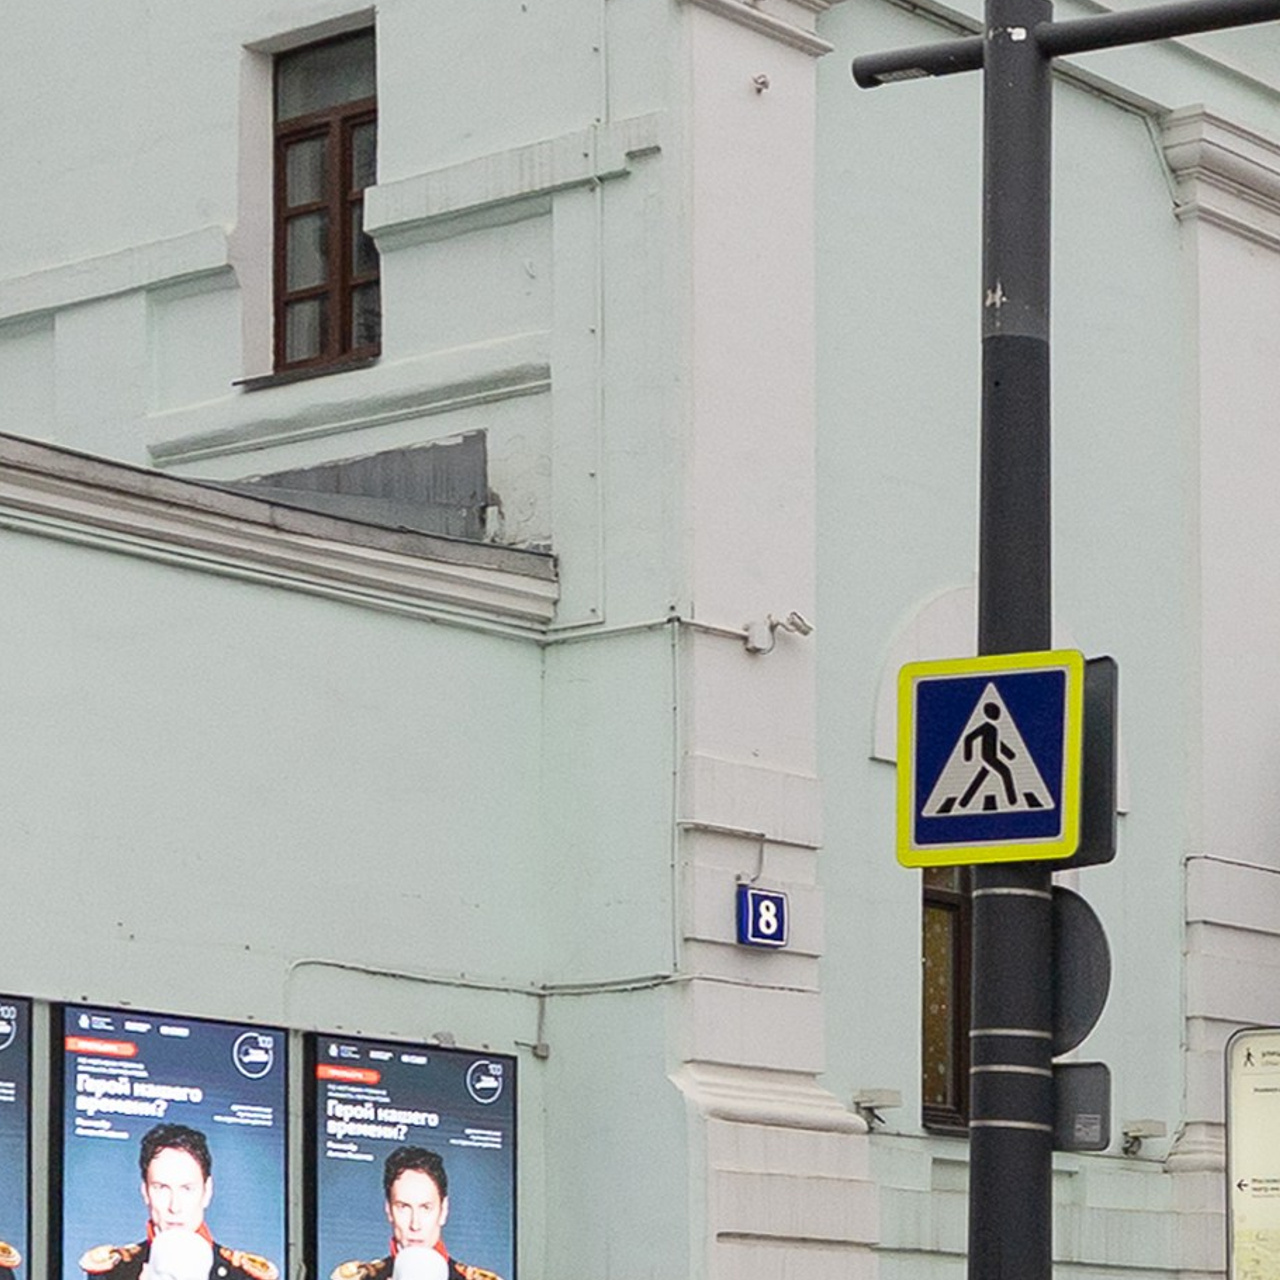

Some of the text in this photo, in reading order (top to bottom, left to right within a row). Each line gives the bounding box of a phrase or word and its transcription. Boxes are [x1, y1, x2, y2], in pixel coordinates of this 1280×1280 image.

[759, 900, 778, 935] 8
[326, 1099, 440, 1127] Герой нашего
[326, 1120, 409, 1140] времени?
